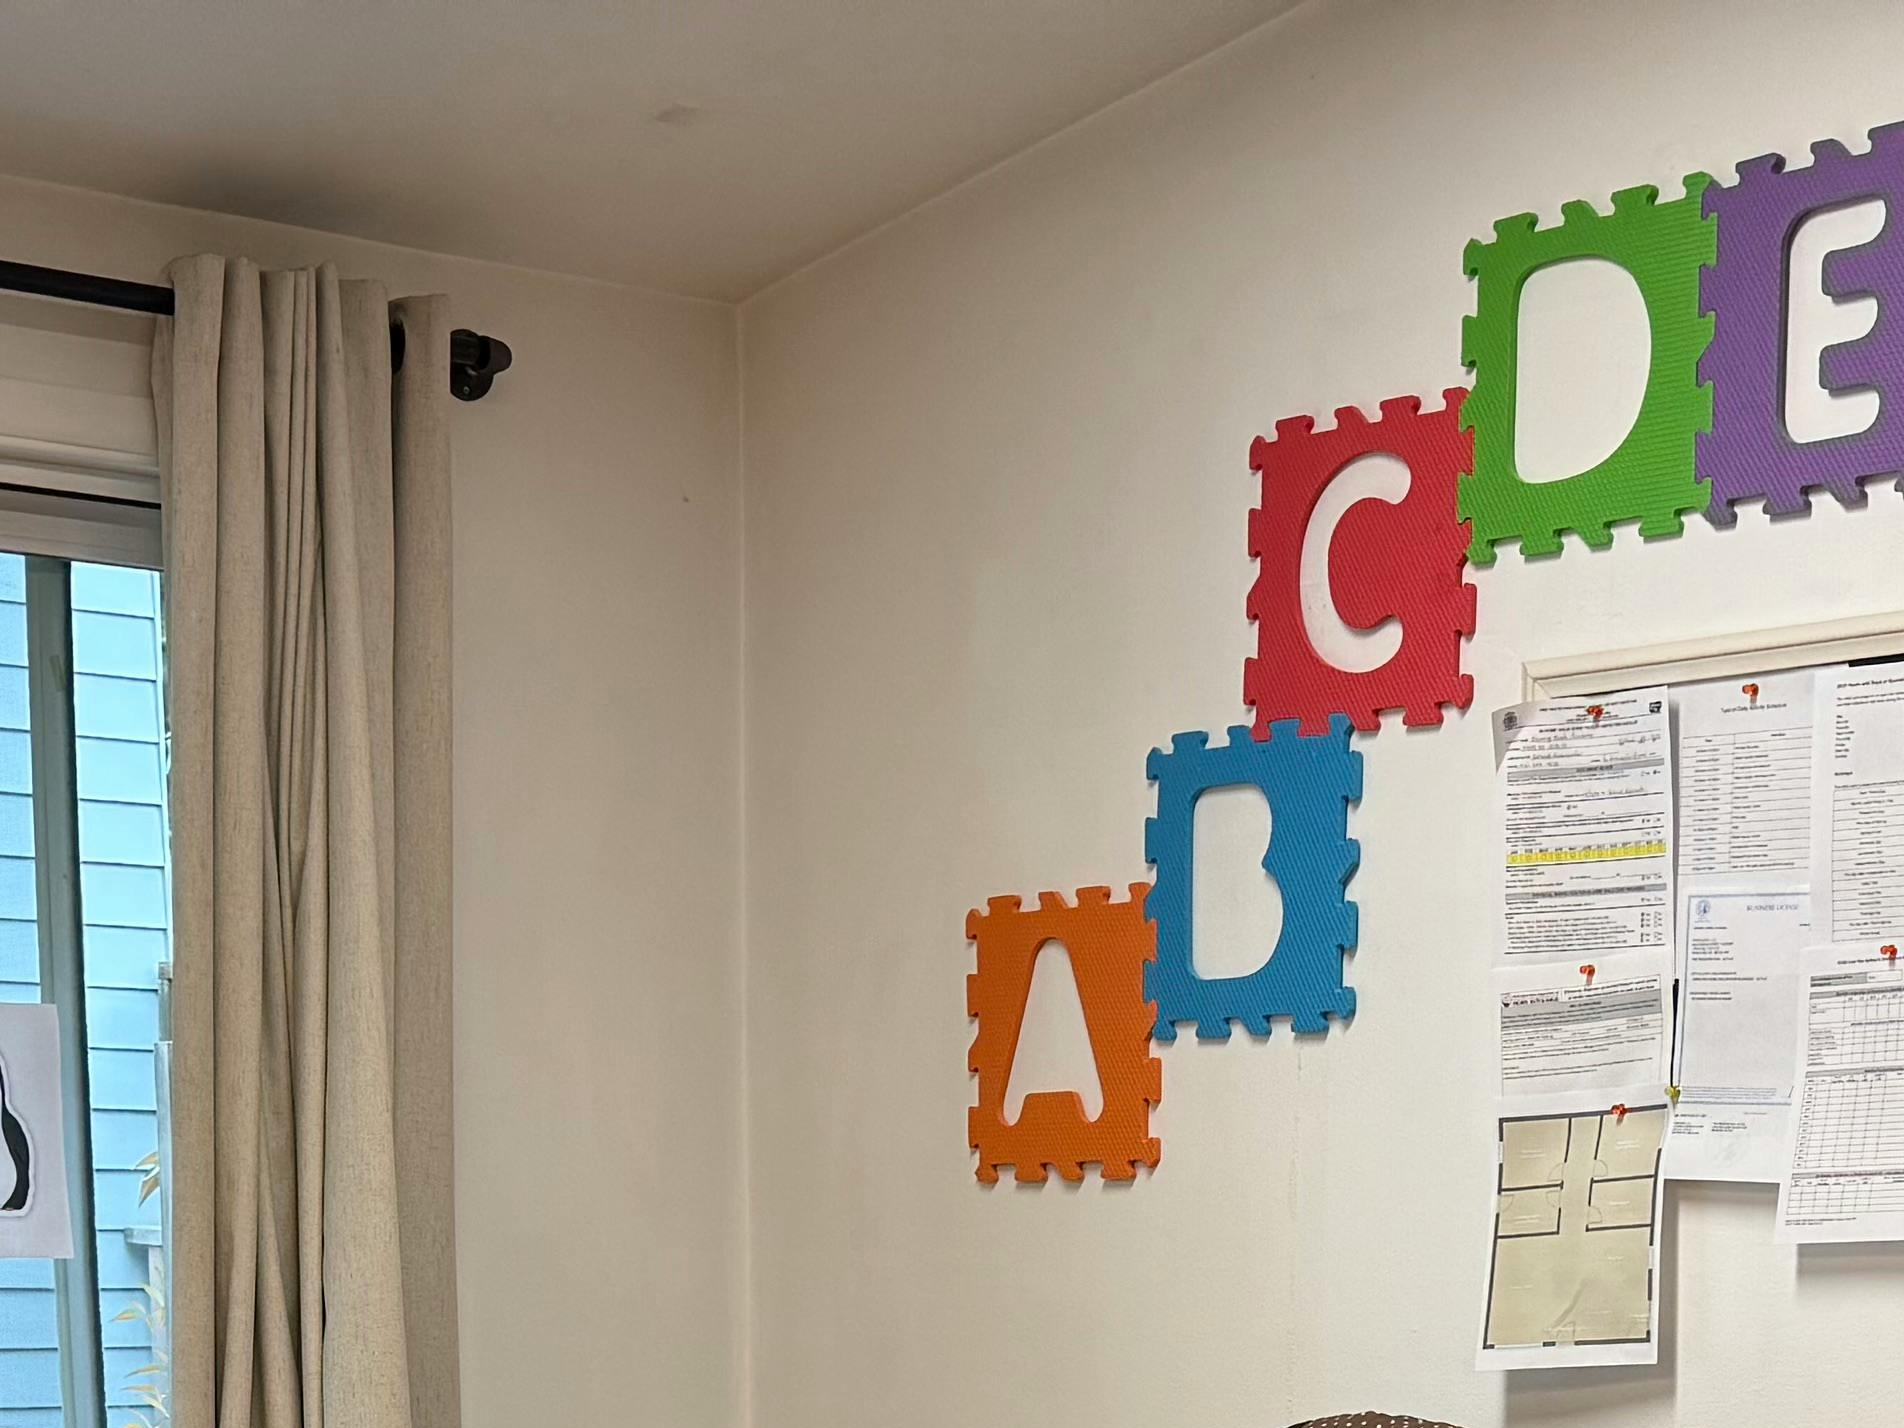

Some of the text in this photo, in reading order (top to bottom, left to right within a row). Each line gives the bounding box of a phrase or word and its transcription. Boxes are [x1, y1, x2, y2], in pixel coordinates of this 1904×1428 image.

[1002, 937, 1106, 1126] A
[1192, 784, 1283, 981] B
[1302, 450, 1410, 672] C
[1515, 256, 1652, 483] D
[1785, 199, 1888, 445] E
